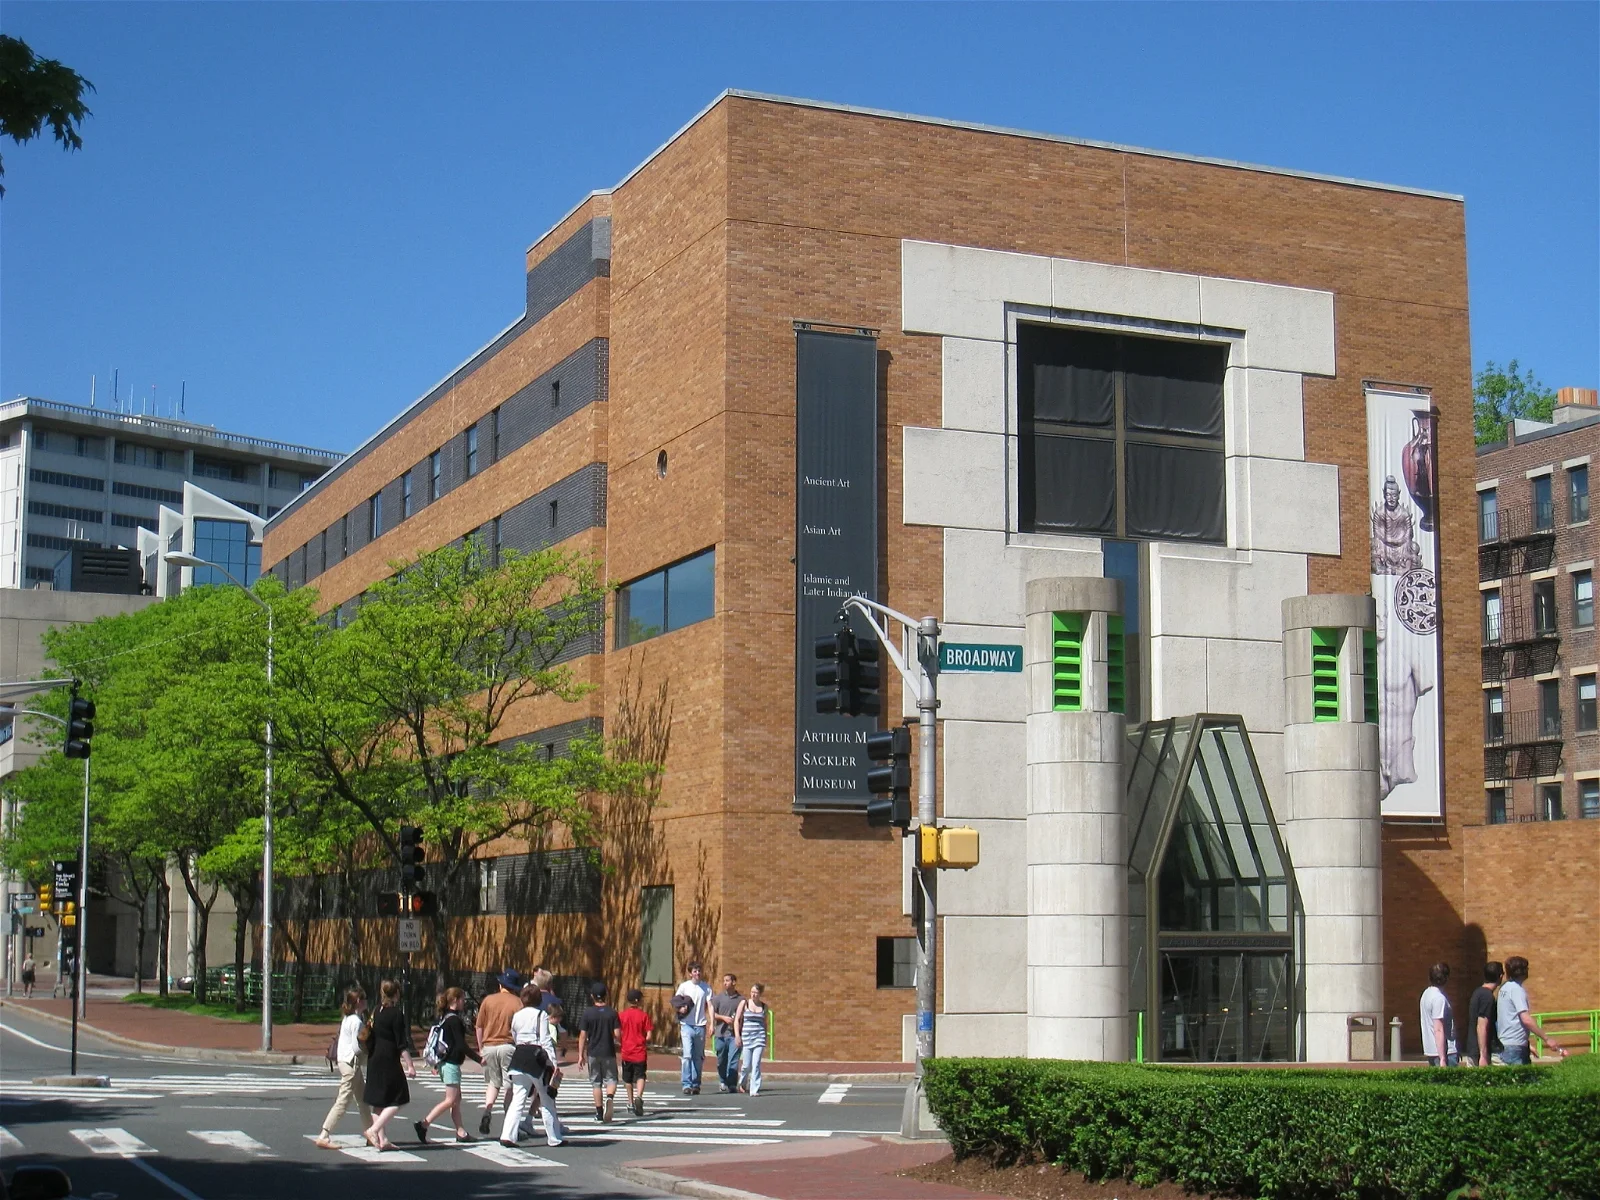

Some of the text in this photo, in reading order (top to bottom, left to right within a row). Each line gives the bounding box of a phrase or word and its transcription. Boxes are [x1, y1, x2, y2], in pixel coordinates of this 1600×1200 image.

[803, 475, 850, 488] Ancient Art
[803, 524, 841, 536] Asian Art
[803, 573, 850, 586] Islamic and
[803, 585, 868, 599] Later Indian Art
[947, 649, 1016, 667] BROADWAY
[802, 729, 867, 744] ARTHUR M
[802, 752, 857, 767] SACKLER
[802, 776, 857, 790] MUSEUM
